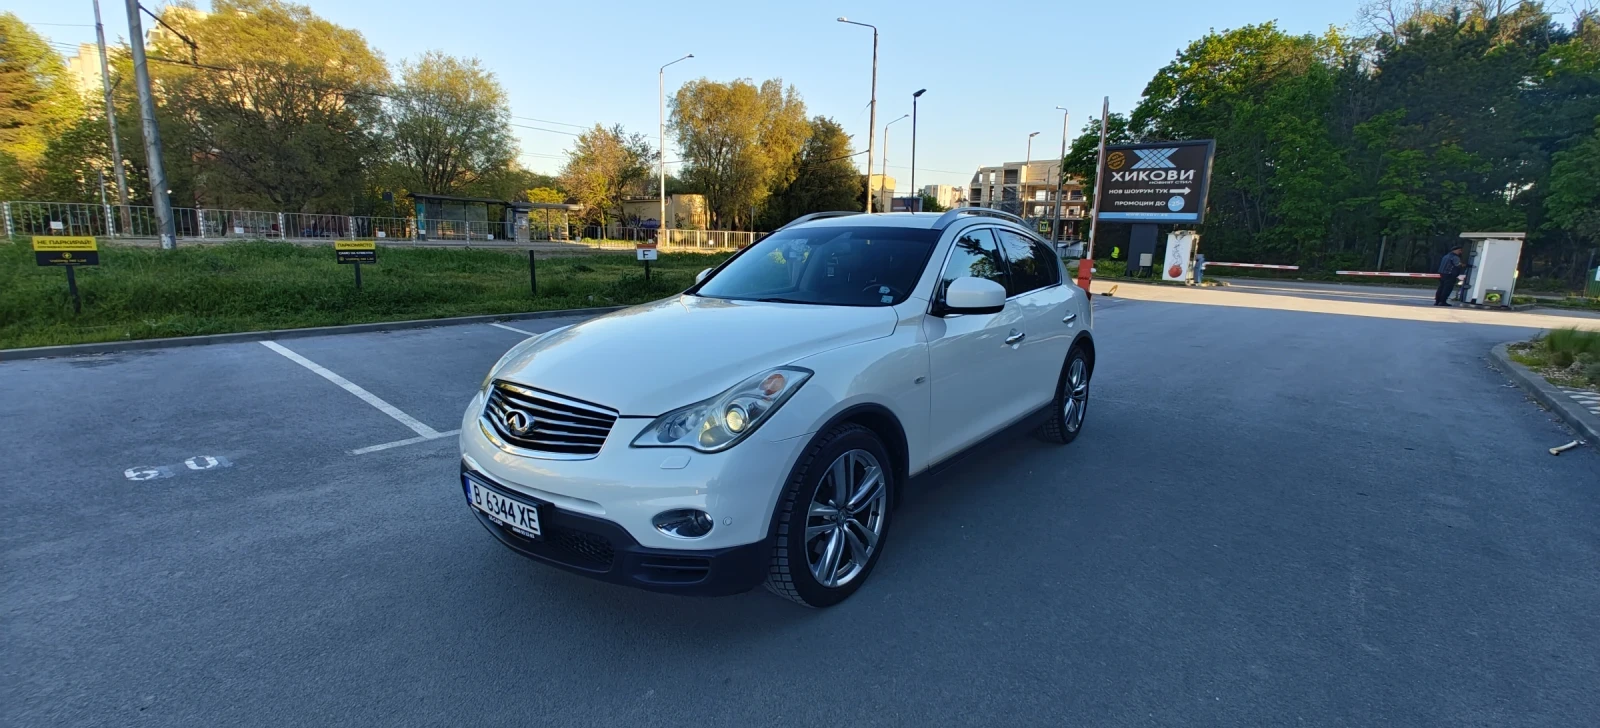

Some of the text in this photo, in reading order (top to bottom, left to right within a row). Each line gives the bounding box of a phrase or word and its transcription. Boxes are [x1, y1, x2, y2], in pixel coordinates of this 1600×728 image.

[1111, 170, 1194, 182] ХИКОВИ
[643, 250, 651, 258] F
[473, 484, 482, 505] B
[486, 491, 516, 523] 6344
[517, 505, 538, 532] XE
